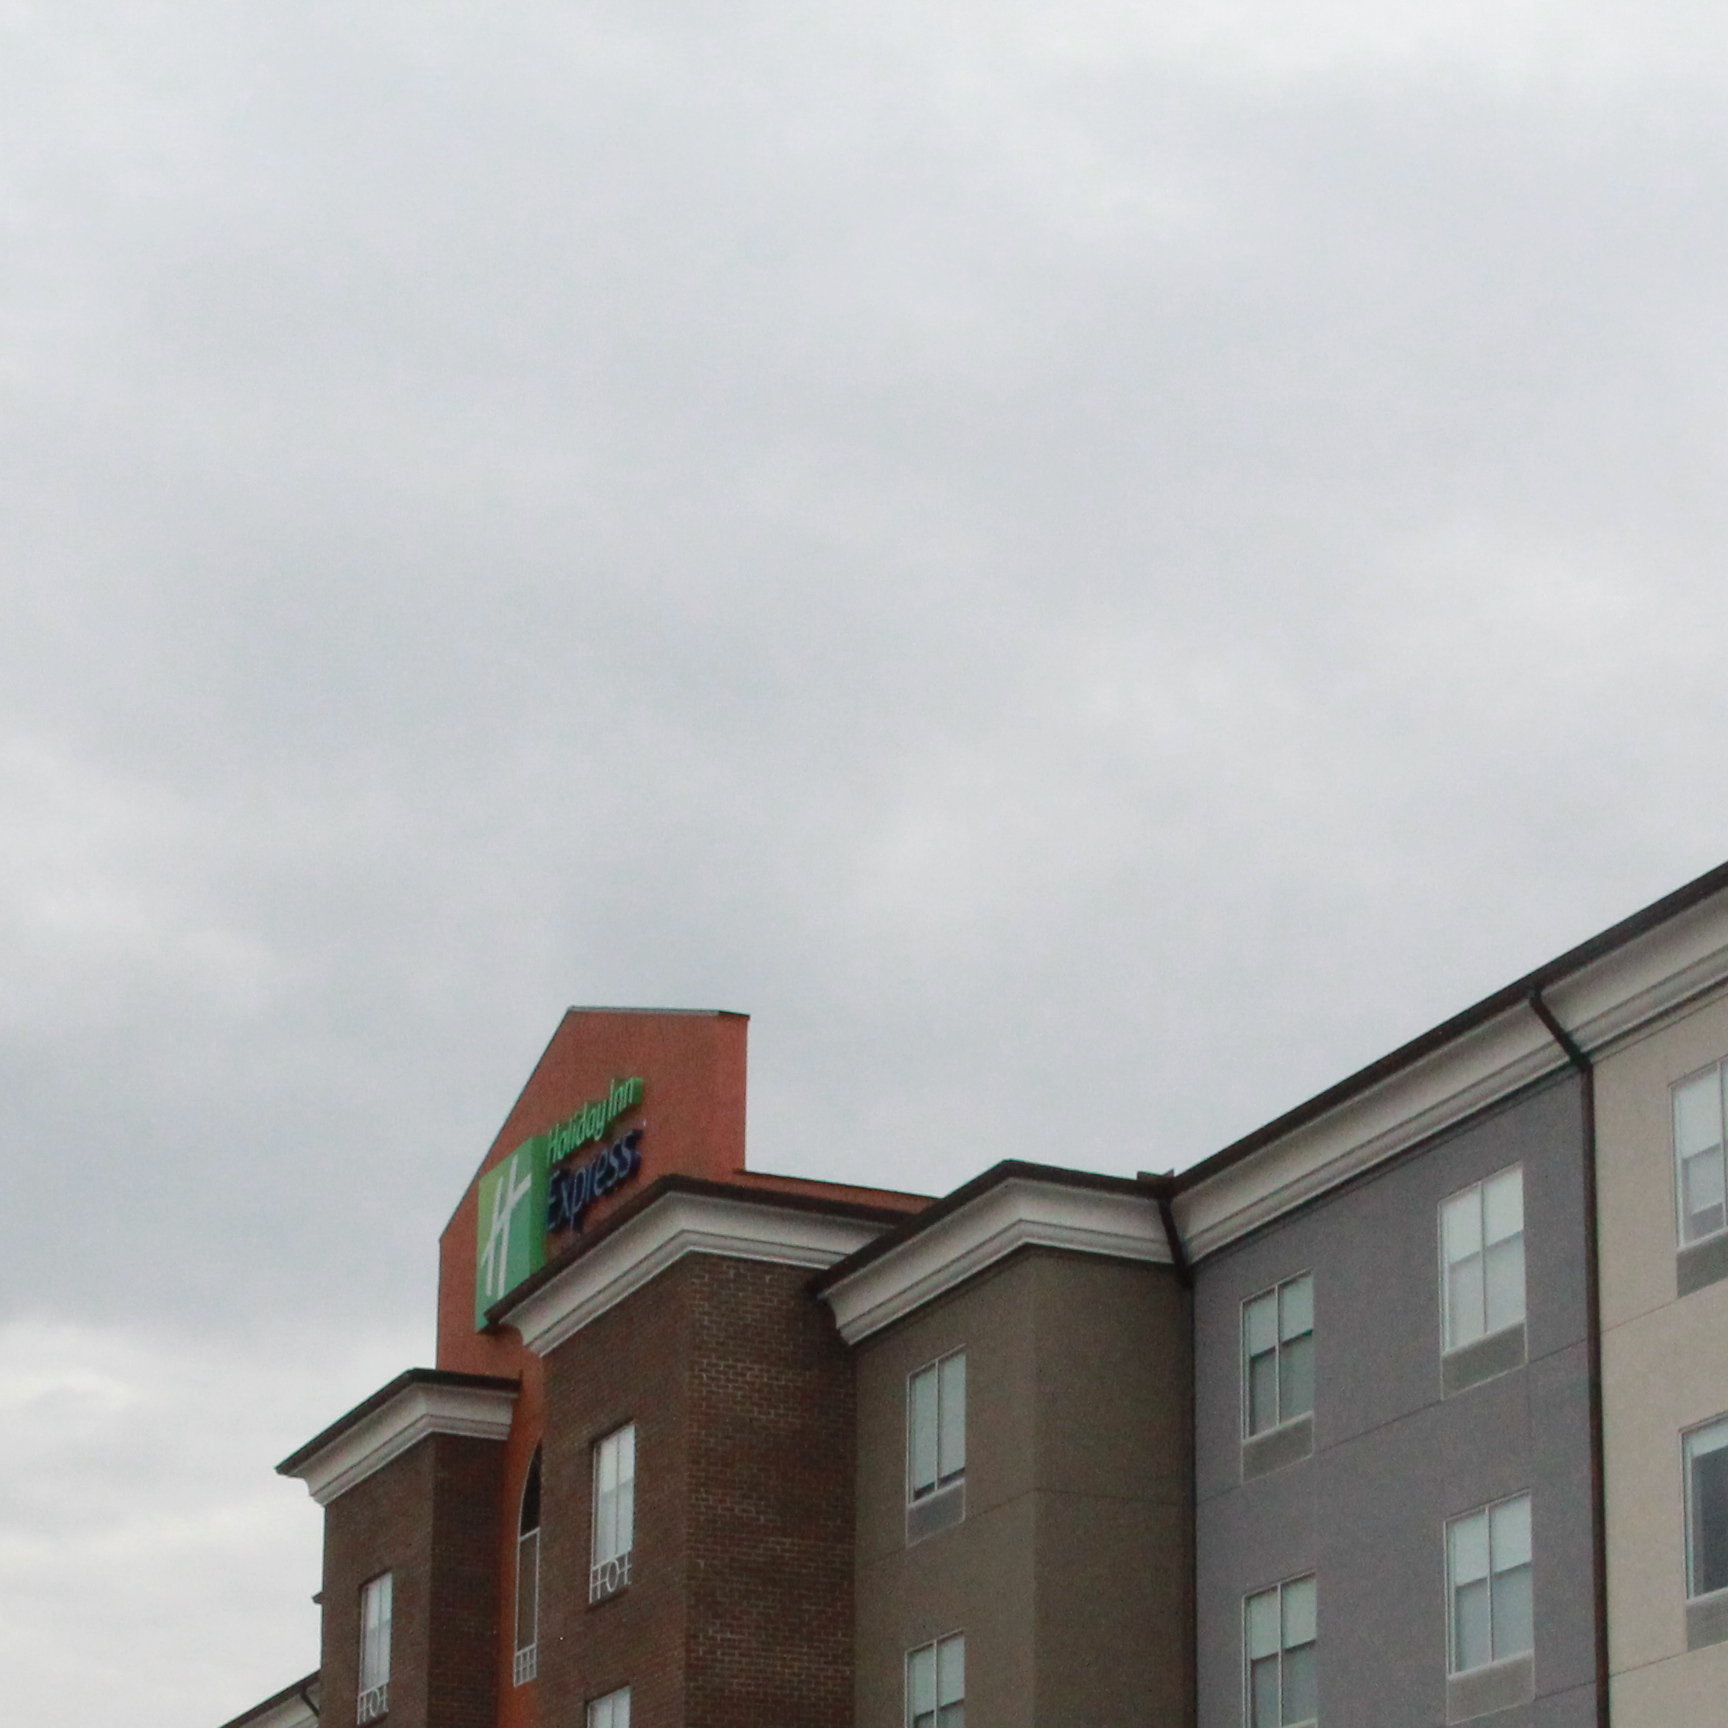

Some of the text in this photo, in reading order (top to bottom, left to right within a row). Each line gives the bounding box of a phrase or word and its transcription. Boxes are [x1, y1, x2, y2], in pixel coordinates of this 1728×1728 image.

[547, 1078, 637, 1167] Holiday Inn
[547, 1129, 638, 1231] Express
